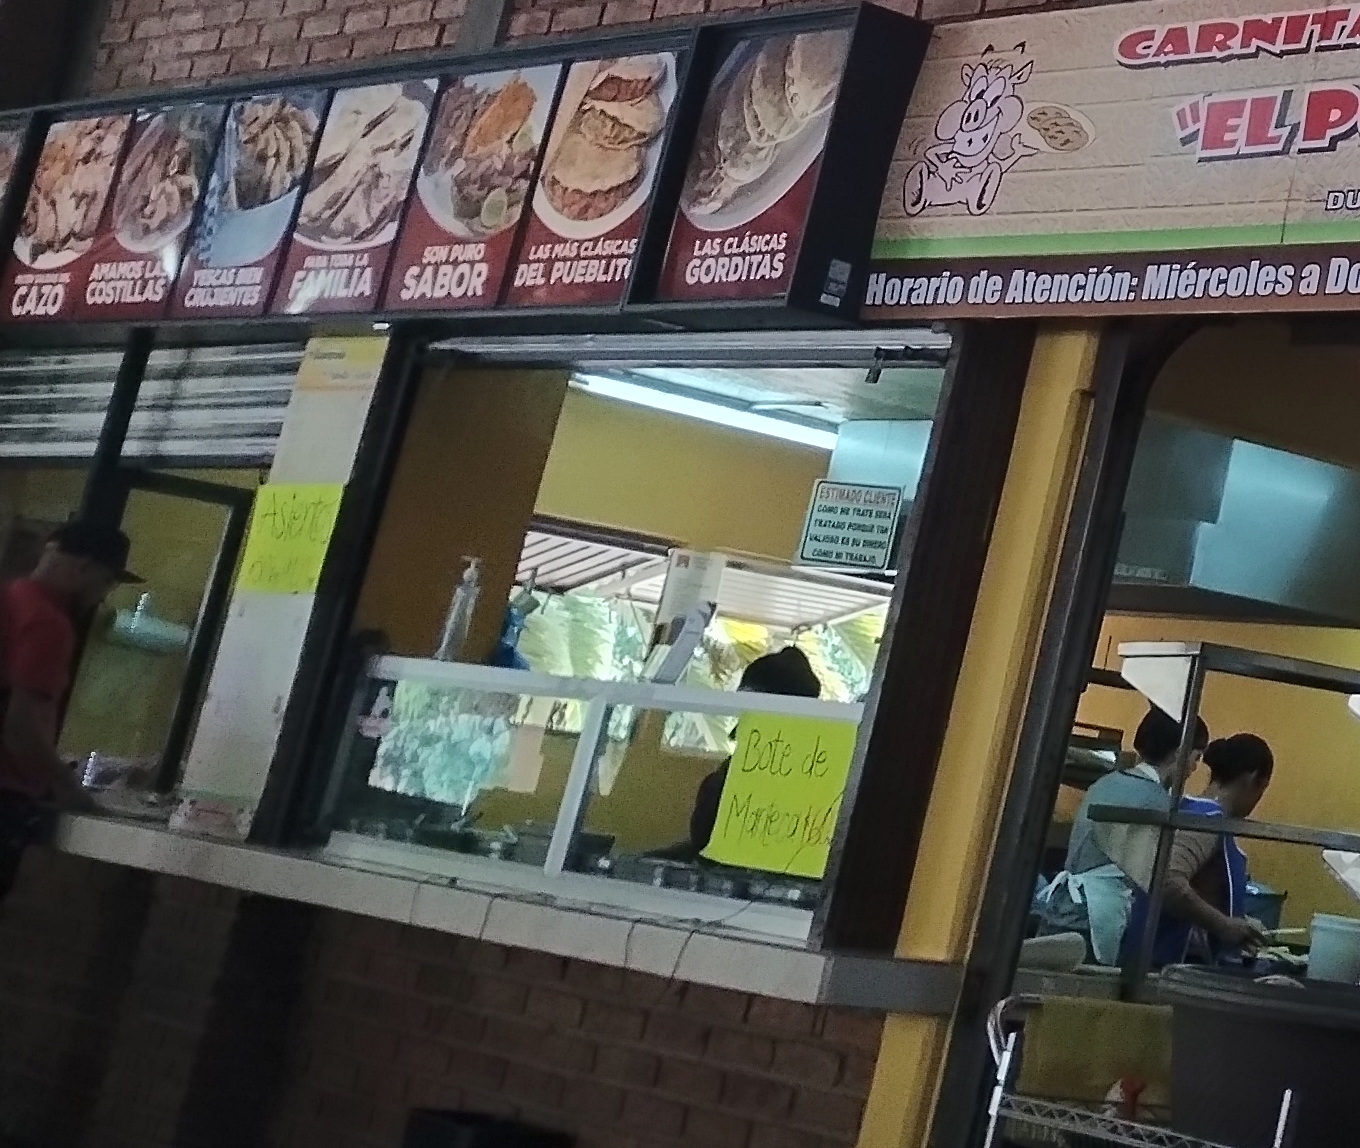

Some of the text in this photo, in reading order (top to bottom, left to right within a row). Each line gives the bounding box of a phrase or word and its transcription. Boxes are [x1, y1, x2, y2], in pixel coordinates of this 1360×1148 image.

[1171, 90, 1295, 162] "EL
[447, 243, 486, 263] PURO
[528, 244, 553, 260] LAS
[693, 230, 788, 256] LAS CLÁSICAS
[288, 267, 373, 300] FAMILIA
[400, 262, 489, 301] SABOR
[513, 262, 546, 288] DEL
[685, 252, 785, 285] GORDITAS
[864, 270, 964, 307] Horario
[967, 270, 1003, 305] de
[1005, 263, 1139, 305] Atención:
[1142, 258, 1294, 301] Miércoles
[1297, 263, 1323, 295] a
[11, 283, 65, 316] CAZO
[85, 278, 167, 306] COSTILLAS
[741, 728, 829, 779] Bote de
